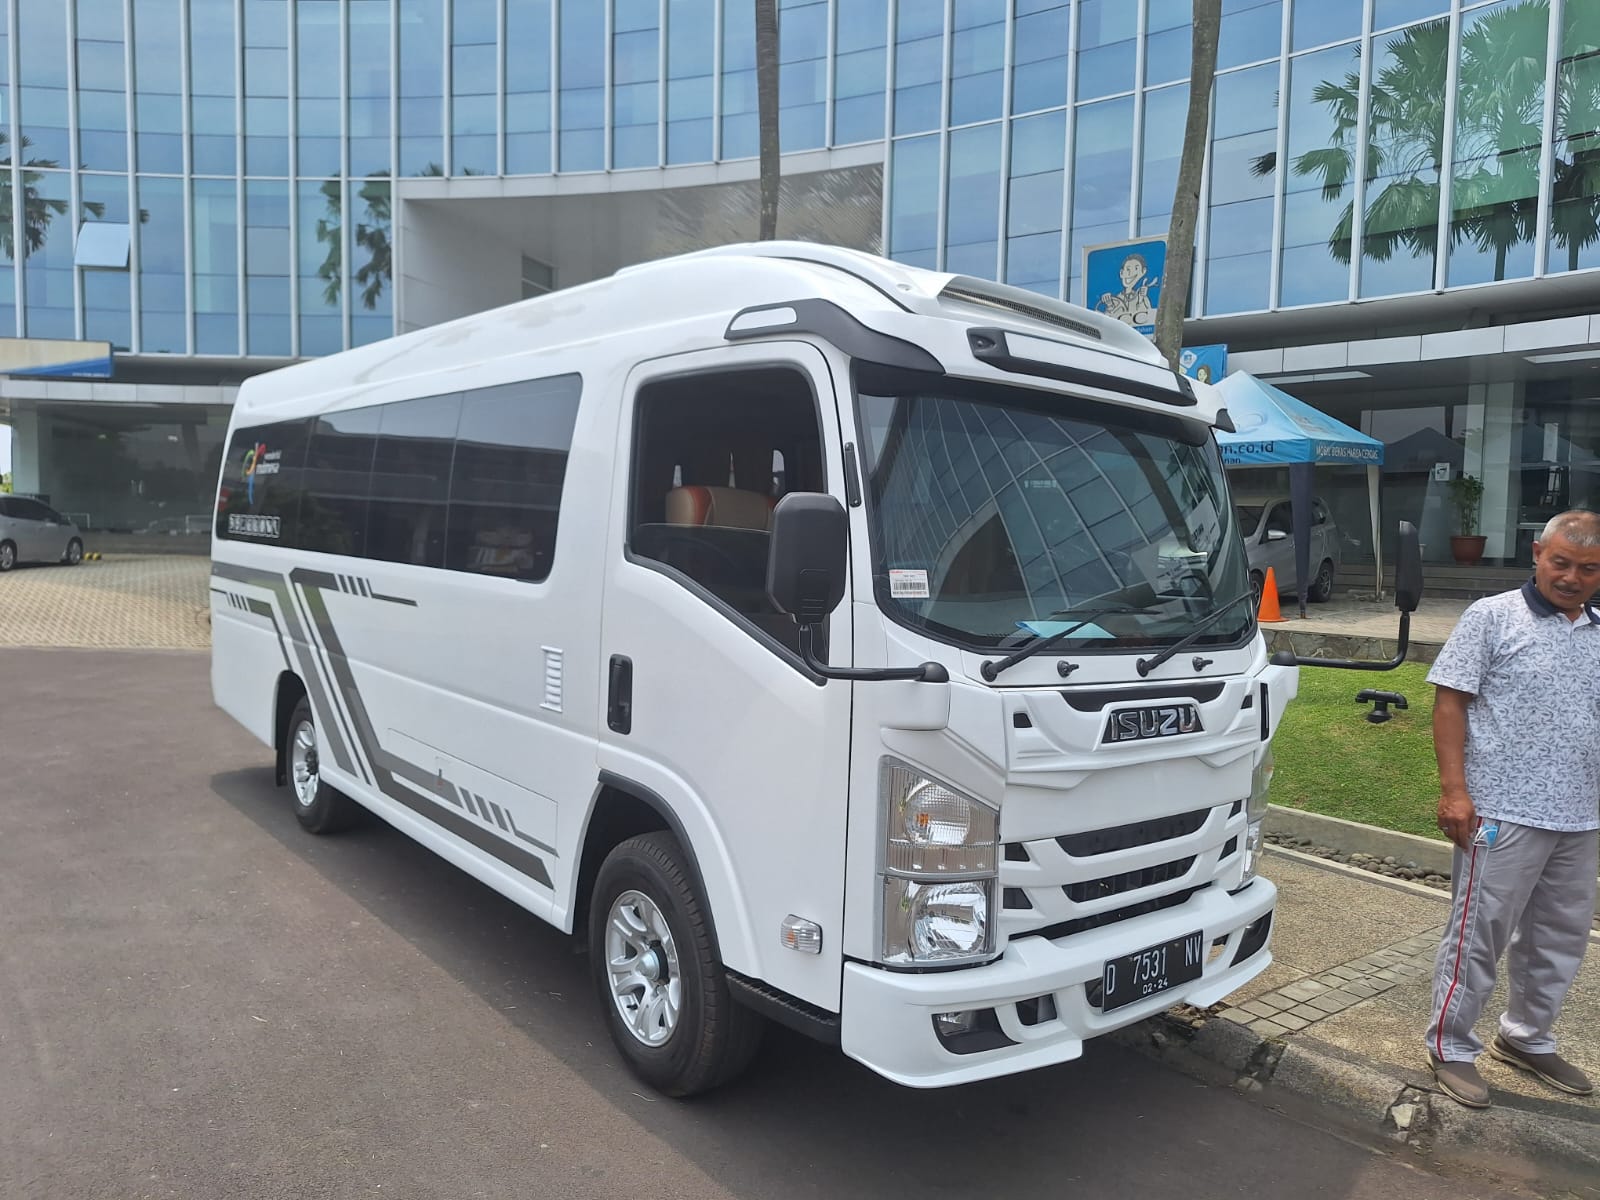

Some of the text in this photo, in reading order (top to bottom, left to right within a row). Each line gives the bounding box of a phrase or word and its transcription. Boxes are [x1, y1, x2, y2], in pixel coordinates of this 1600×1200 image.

[1110, 706, 1196, 740] ISUZU
[1106, 935, 1201, 996] D 7531 NV
